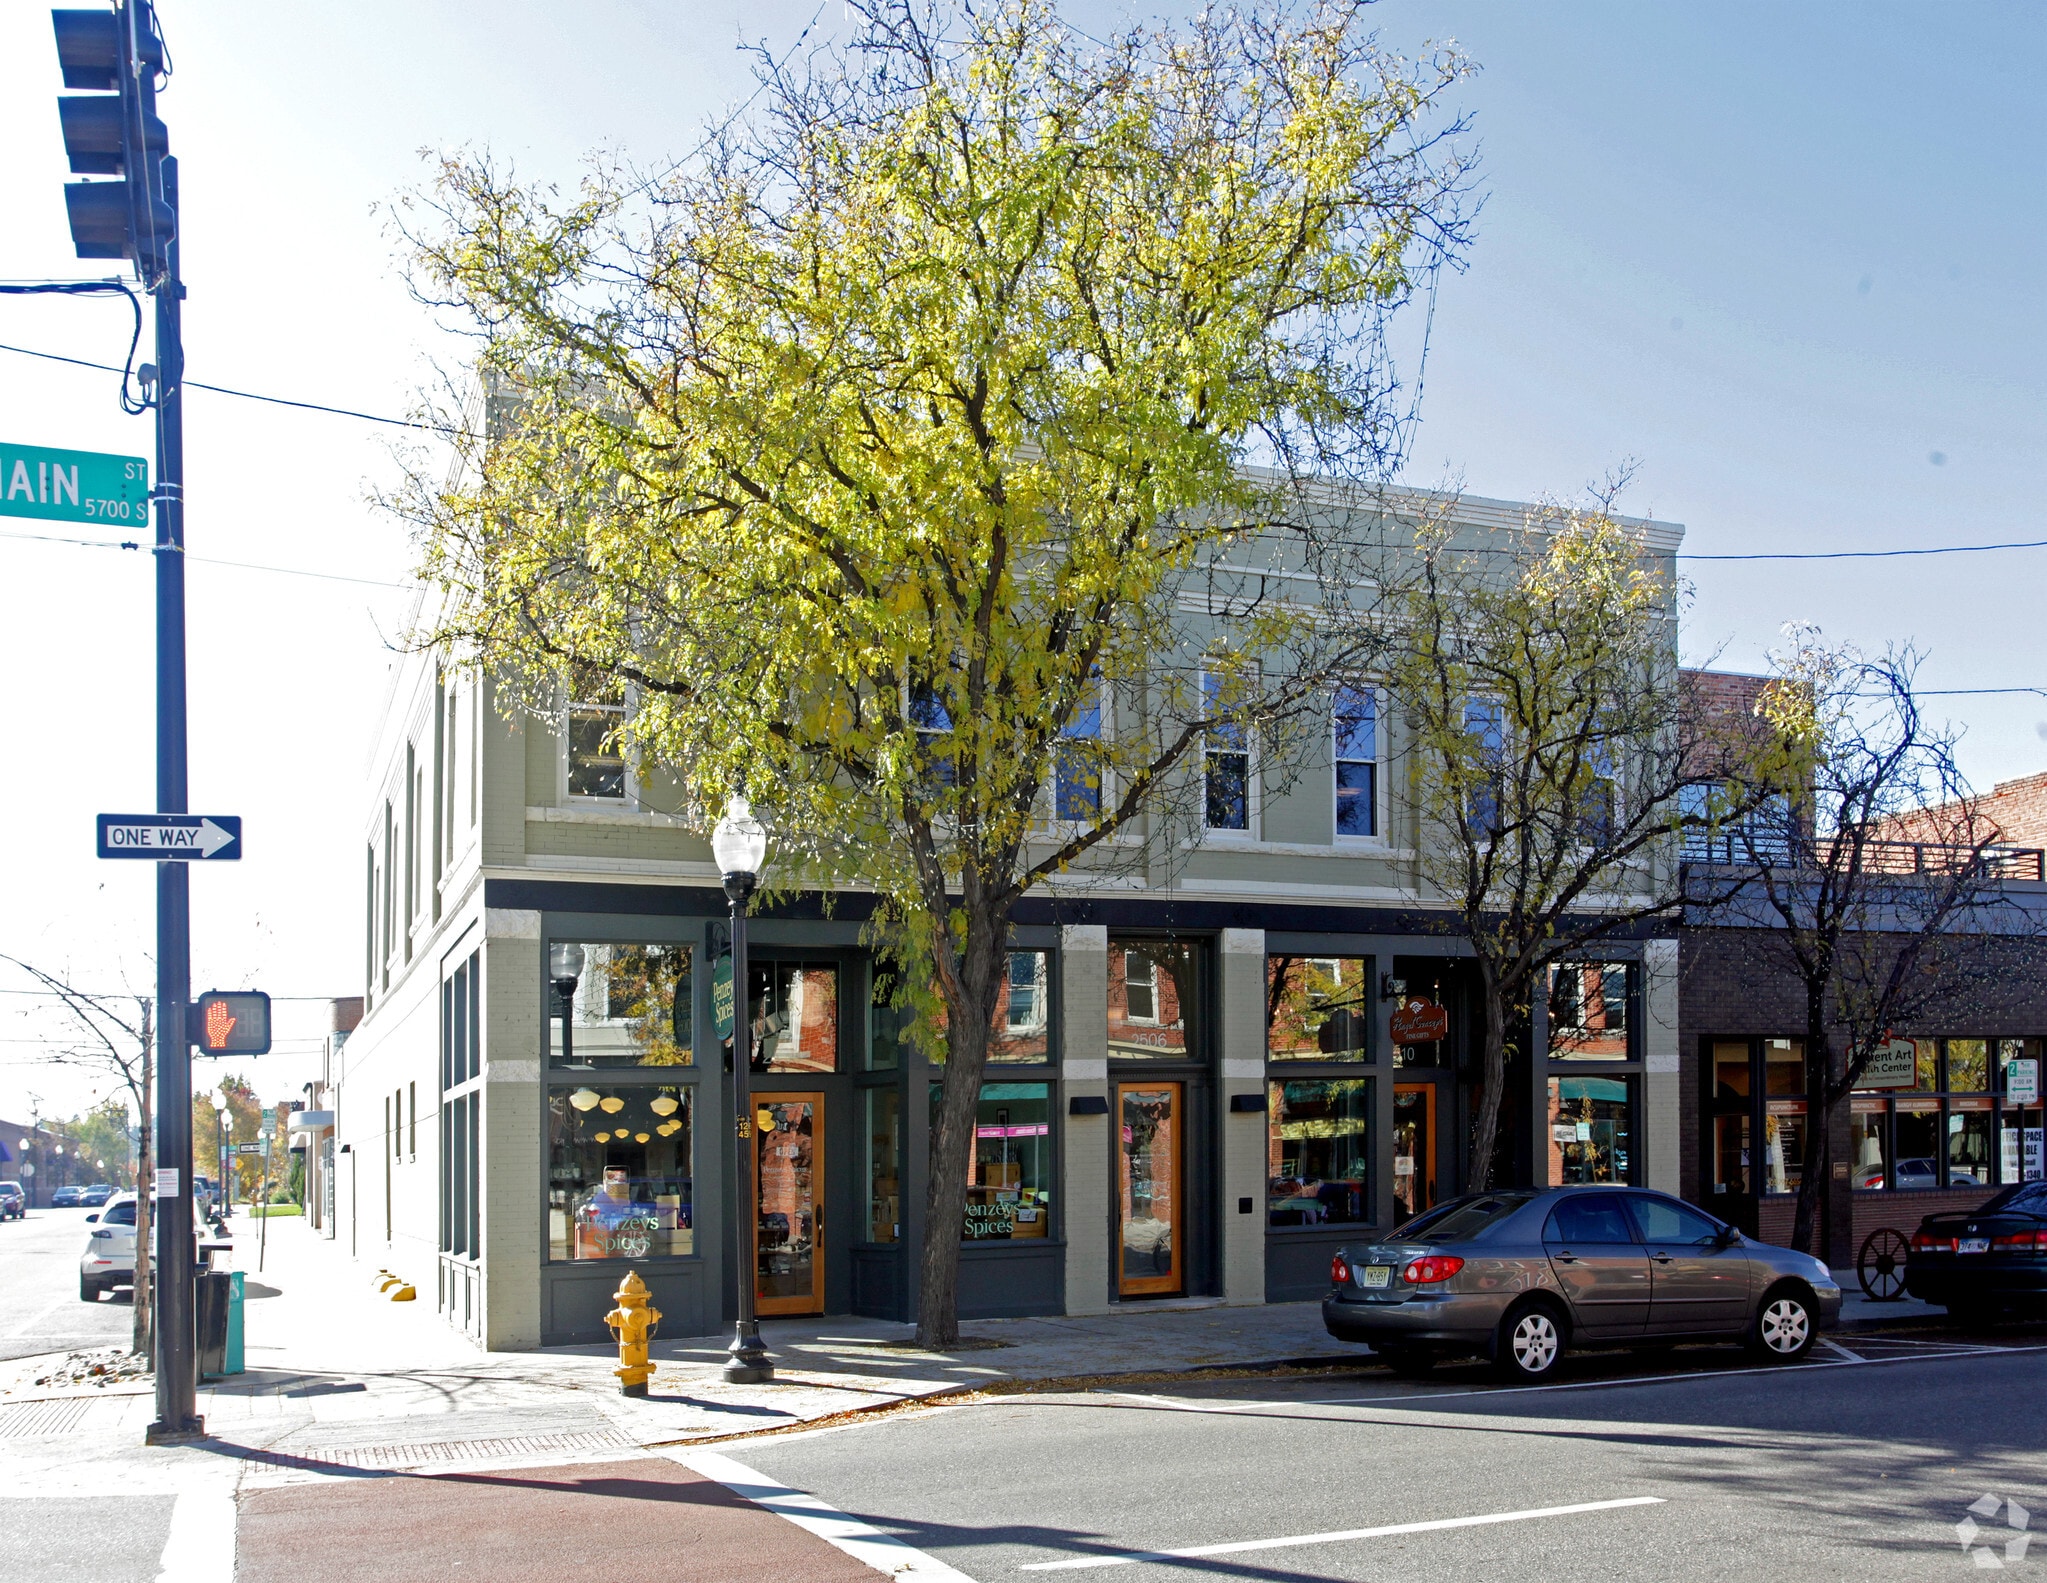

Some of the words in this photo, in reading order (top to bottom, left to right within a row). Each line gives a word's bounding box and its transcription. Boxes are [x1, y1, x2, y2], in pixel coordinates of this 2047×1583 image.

[124, 462, 146, 481] ST
[0, 458, 80, 507] AIN
[84, 498, 130, 519] 5700
[135, 502, 147, 521] S
[112, 828, 152, 846] ONE
[159, 829, 199, 846] WAY
[716, 1001, 734, 1028] Spices
[1131, 1032, 1168, 1048] 2506
[1895, 1049, 1912, 1061] Art
[1881, 1063, 1912, 1073] Center
[2009, 1063, 2016, 1075] 2
[586, 1215, 659, 1233] Penzeys
[964, 1218, 1014, 1238] Spices
[594, 1234, 651, 1254] Spices
